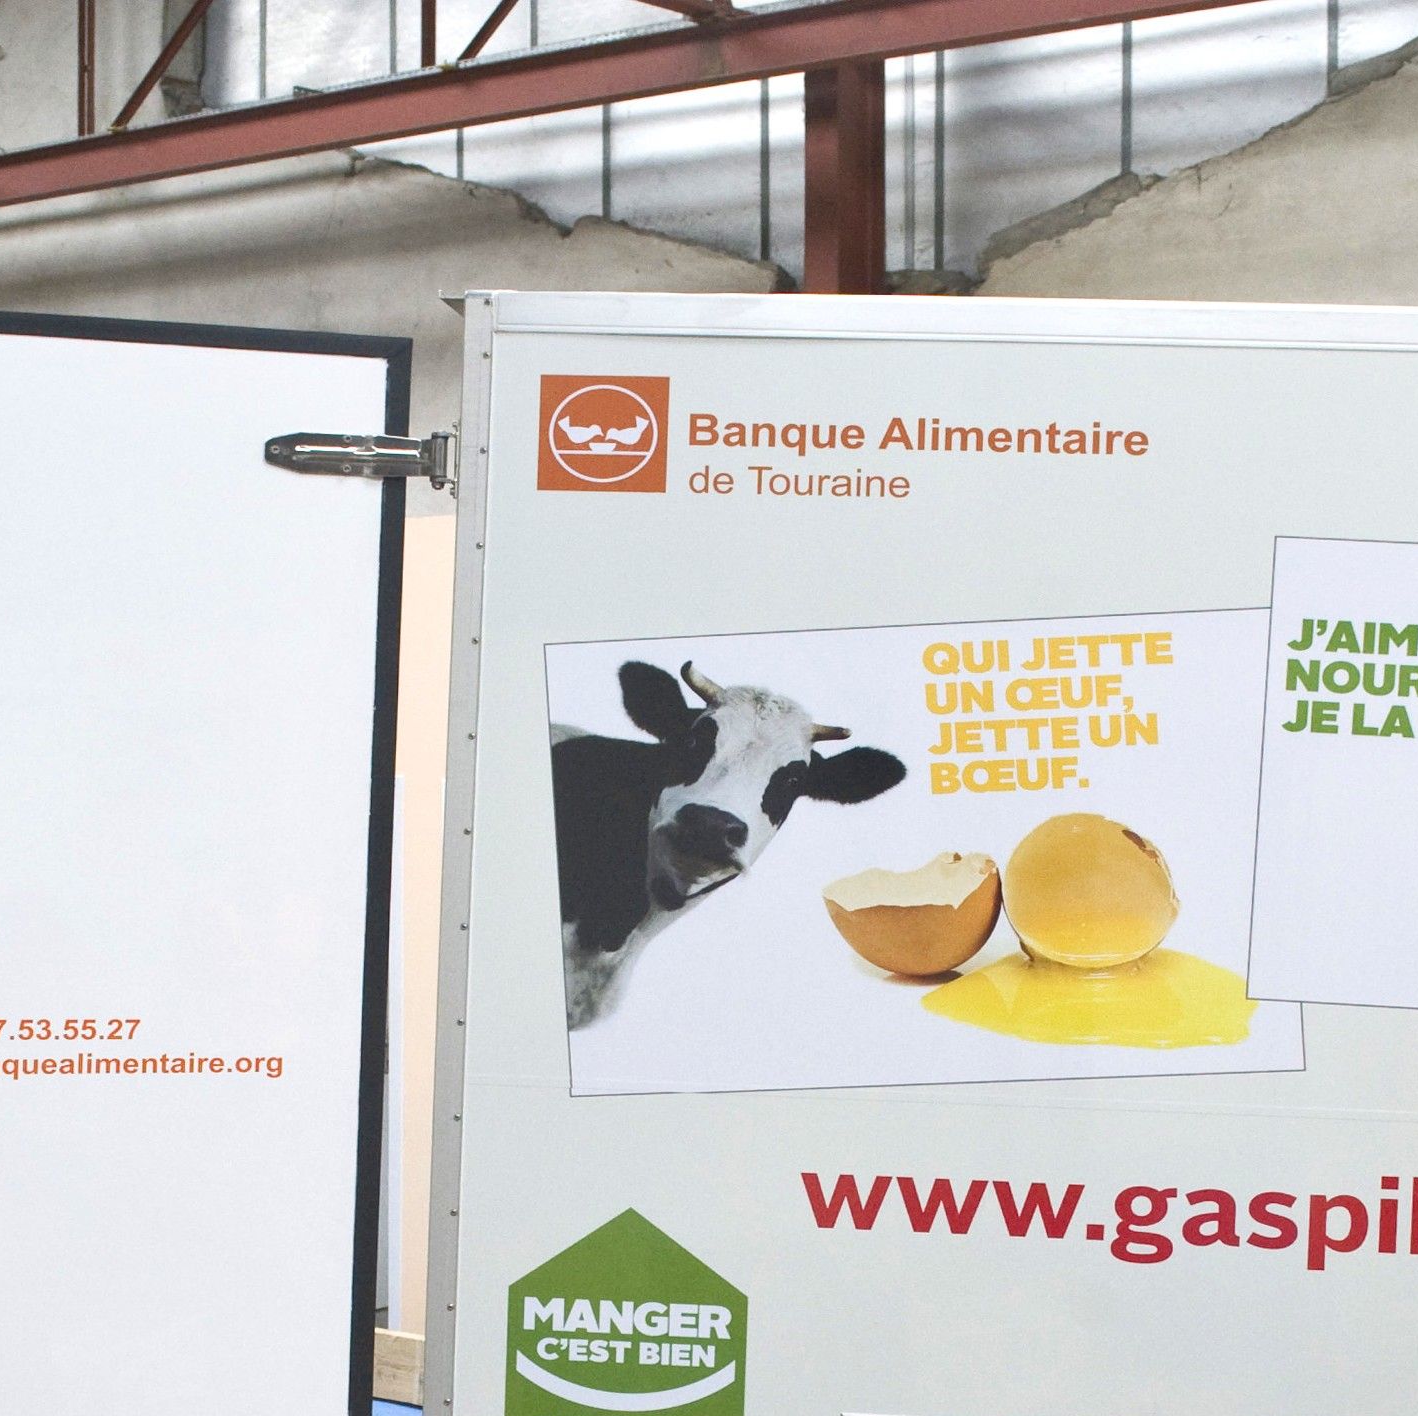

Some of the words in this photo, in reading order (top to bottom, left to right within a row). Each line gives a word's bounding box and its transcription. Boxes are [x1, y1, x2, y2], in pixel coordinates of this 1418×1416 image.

[688, 412, 865, 456] Banque
[880, 416, 1150, 456] Alimentaire
[688, 466, 734, 495] de
[748, 465, 911, 499] Touraine
[922, 641, 1011, 677] QUI
[1021, 632, 1174, 671] JETTE
[925, 682, 996, 716] UN
[1005, 673, 1135, 714] ŒUF,
[927, 717, 1080, 756] JETTE
[1089, 713, 1159, 747] UN
[1282, 699, 1340, 735] JE
[1351, 703, 1416, 739] LA
[930, 756, 1090, 795] BŒUF.
[523, 1296, 732, 1340] MANGER
[537, 1337, 632, 1365] C'EST
[638, 1342, 715, 1368] BIEN
